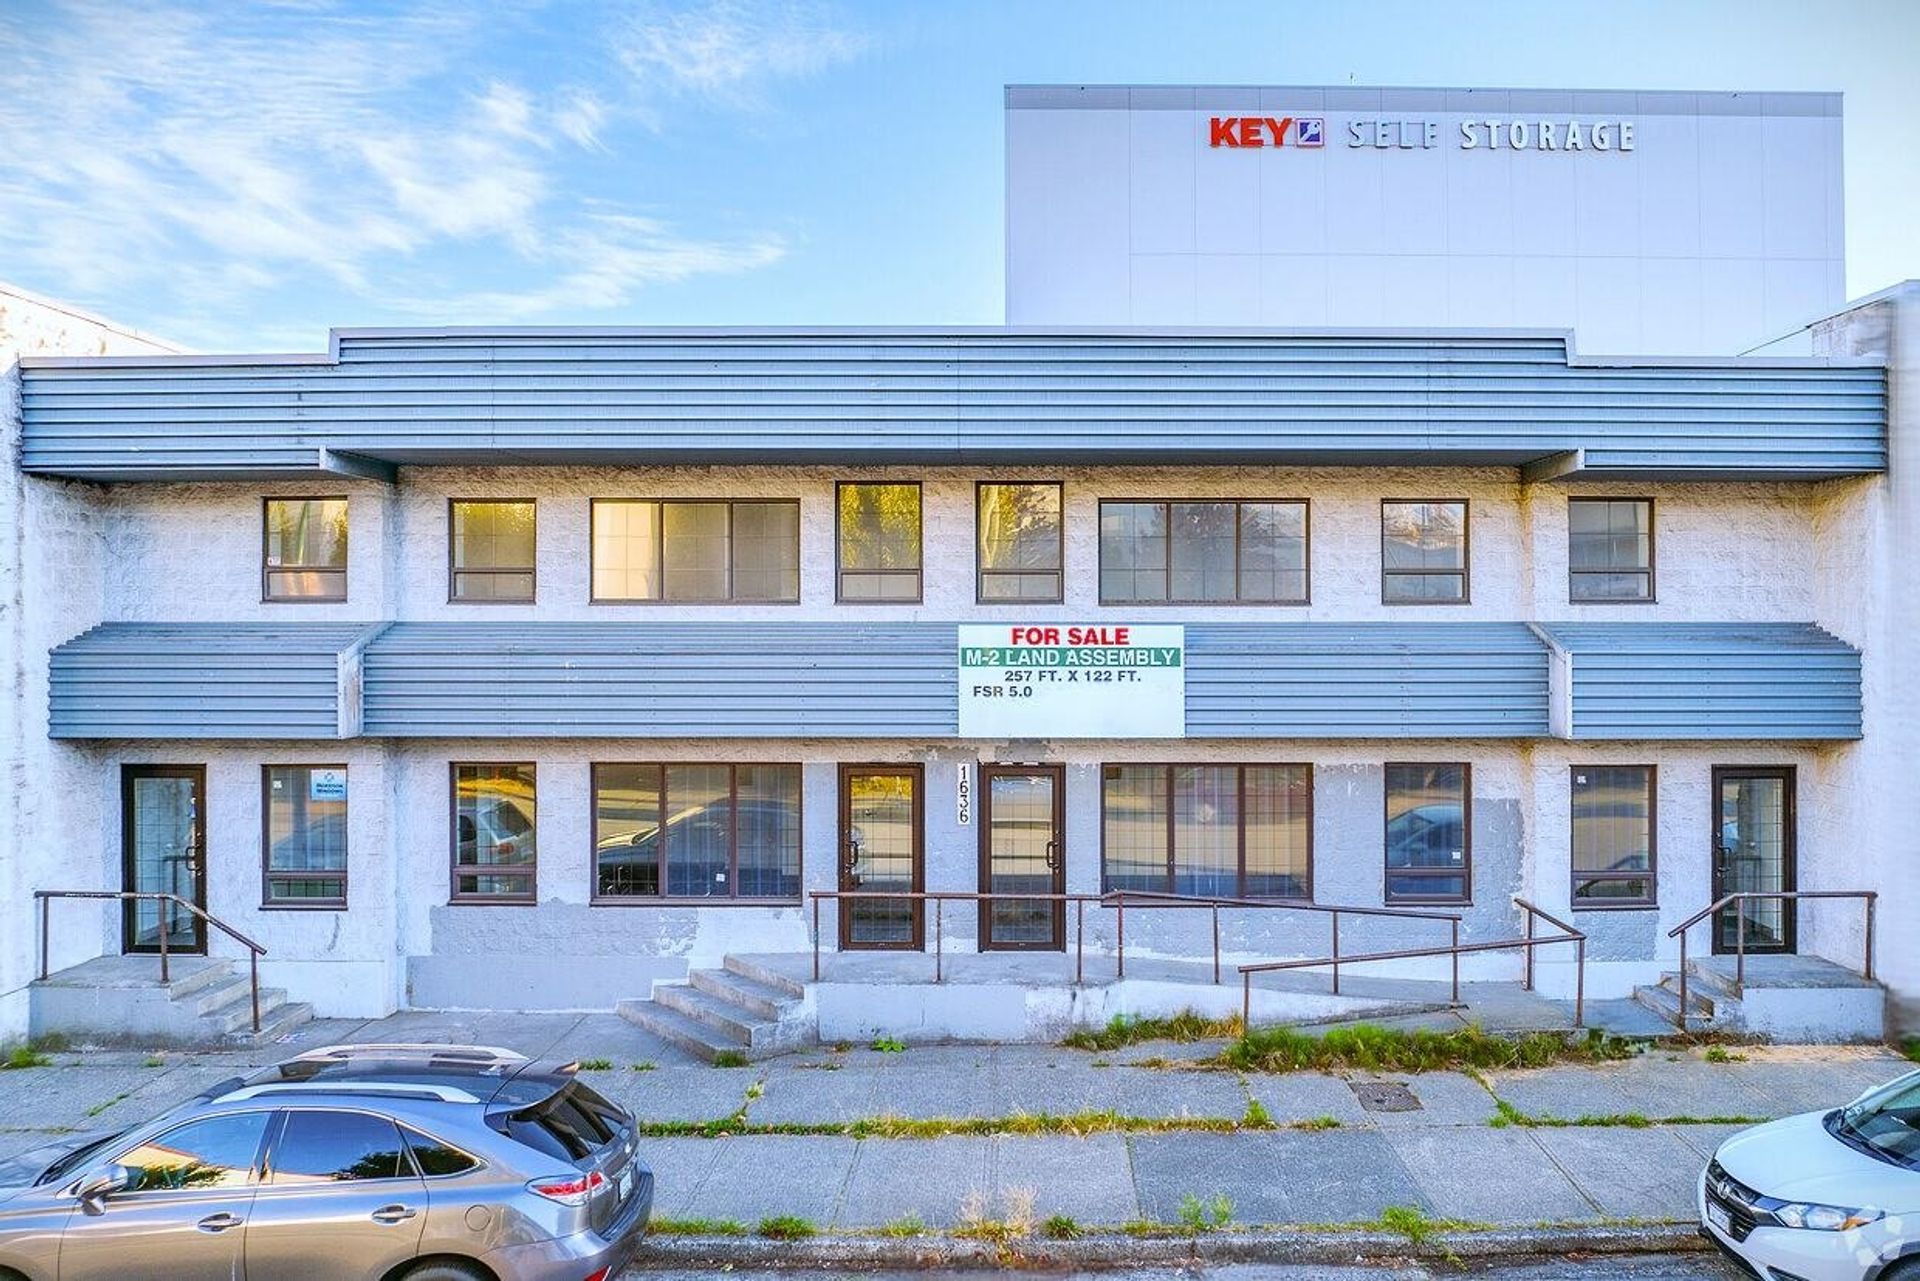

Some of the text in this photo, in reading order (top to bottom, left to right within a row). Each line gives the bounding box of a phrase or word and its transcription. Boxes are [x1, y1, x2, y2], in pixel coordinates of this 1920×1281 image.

[1210, 117, 1634, 151] KEY SELF STORAGE
[1012, 627, 1130, 645] FOR SALE
[966, 649, 1175, 666] M-2 LAND ASSEMBLY
[1004, 670, 1141, 682] 257 FT. X 122 FT.
[973, 686, 1033, 697] FSR 5.0
[959, 765, 969, 823] 1636
